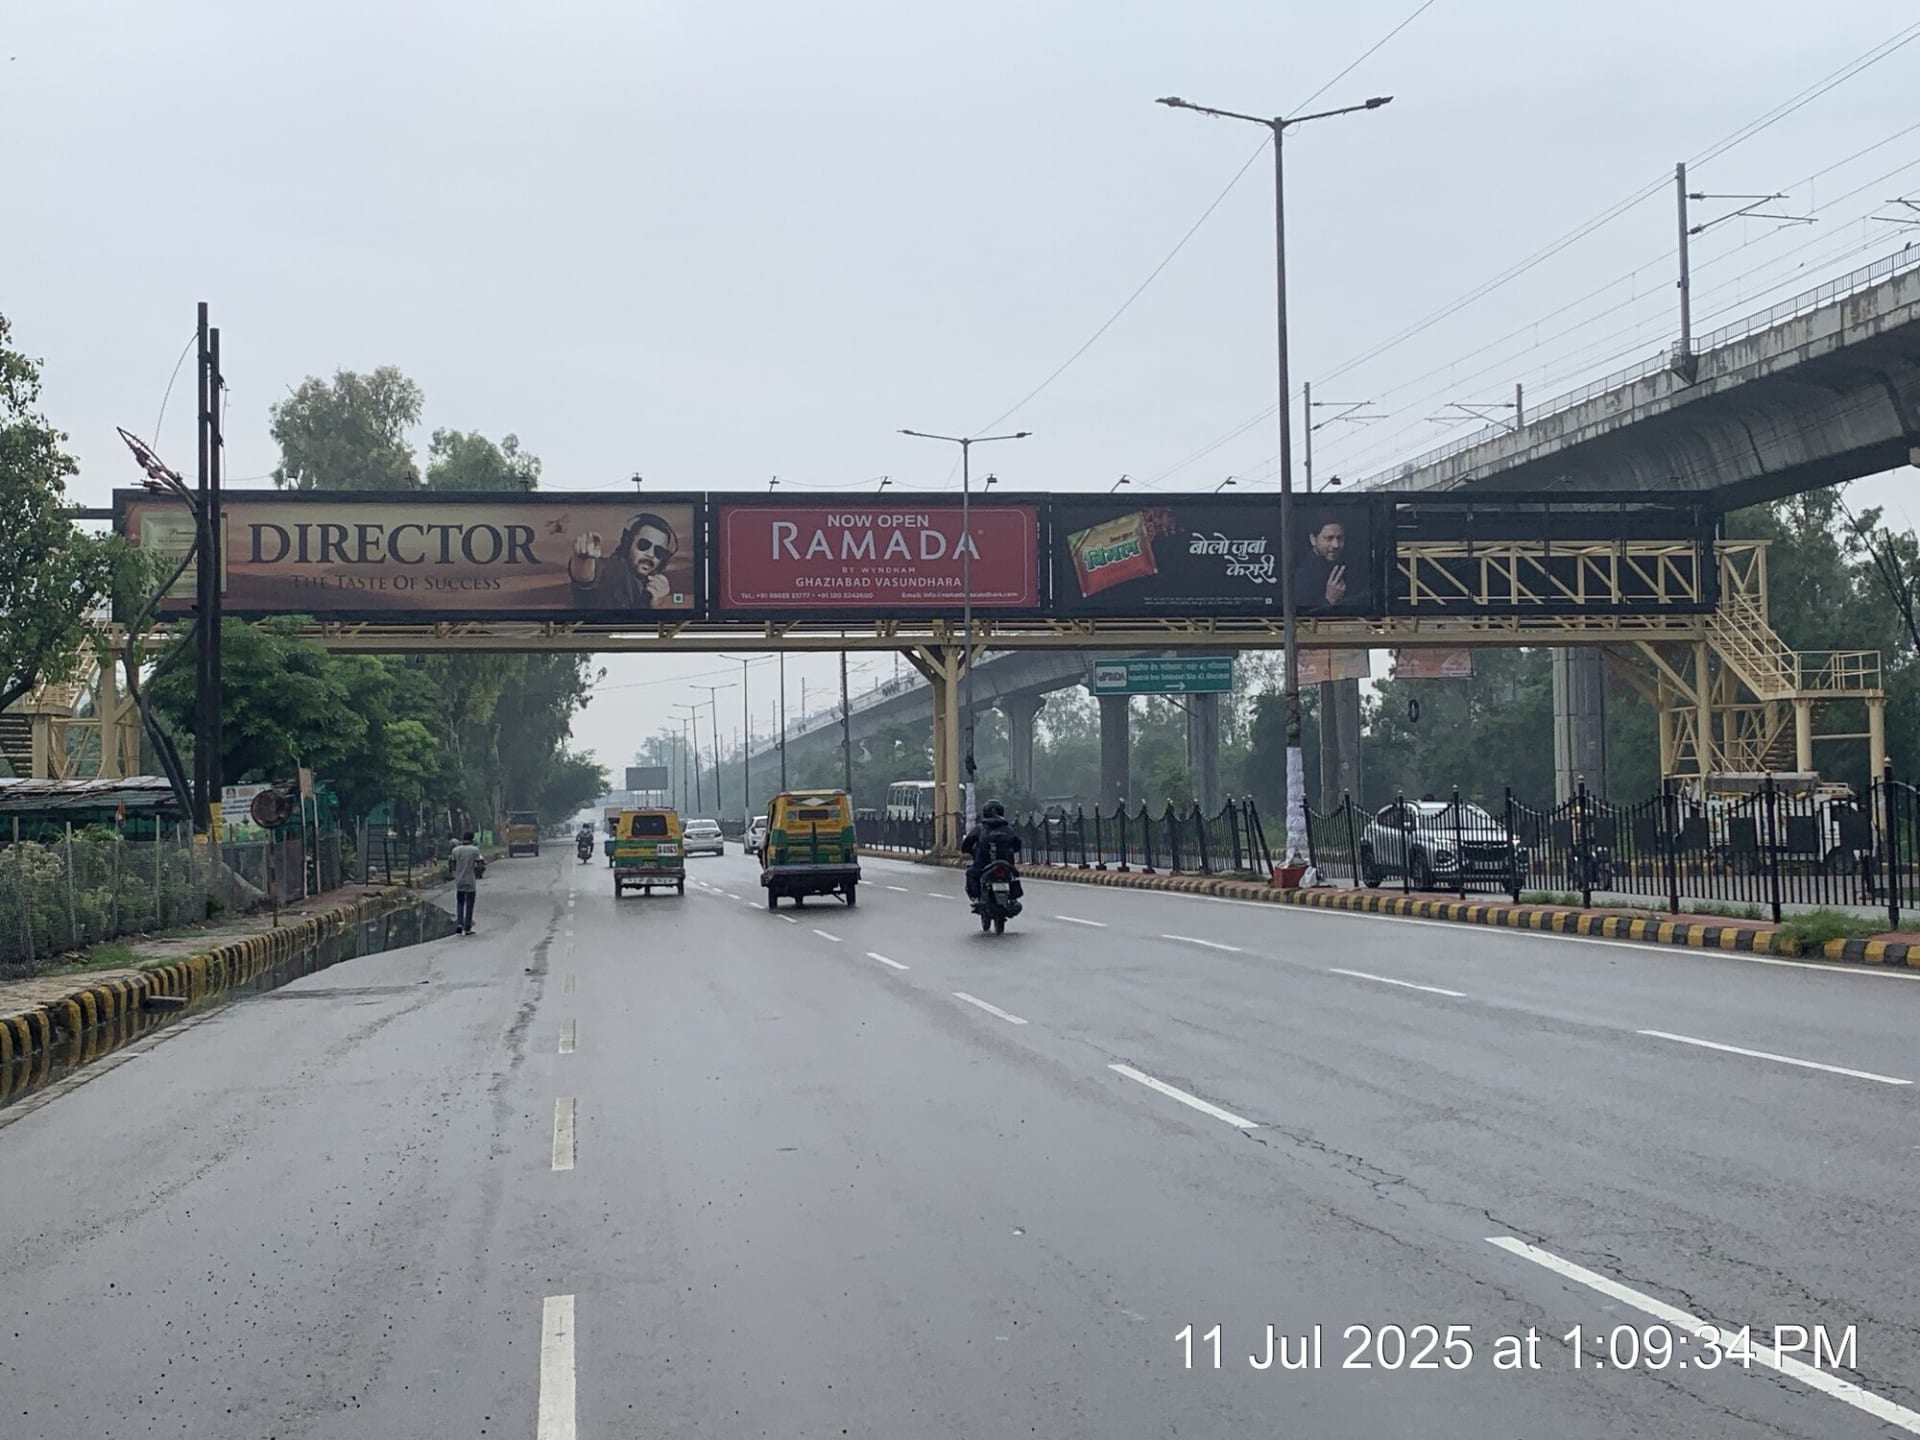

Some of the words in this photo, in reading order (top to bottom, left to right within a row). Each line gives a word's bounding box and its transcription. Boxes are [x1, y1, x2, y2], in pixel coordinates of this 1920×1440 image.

[827, 514, 871, 528] NOW
[877, 514, 929, 528] OPEN
[248, 523, 541, 565] DIRECTOR
[772, 521, 981, 561] RAMADA
[1189, 532, 1231, 555] बोलो
[842, 566, 854, 574] BY
[861, 566, 916, 574] WYNDHAM
[1224, 554, 1278, 584] केसरी
[292, 575, 326, 591] THE
[334, 575, 387, 591] TASTE
[393, 575, 418, 591] OF
[424, 575, 501, 591] SUCCESS
[795, 577, 871, 588] GHAZIABAD
[874, 577, 962, 588] VASUNDHARA
